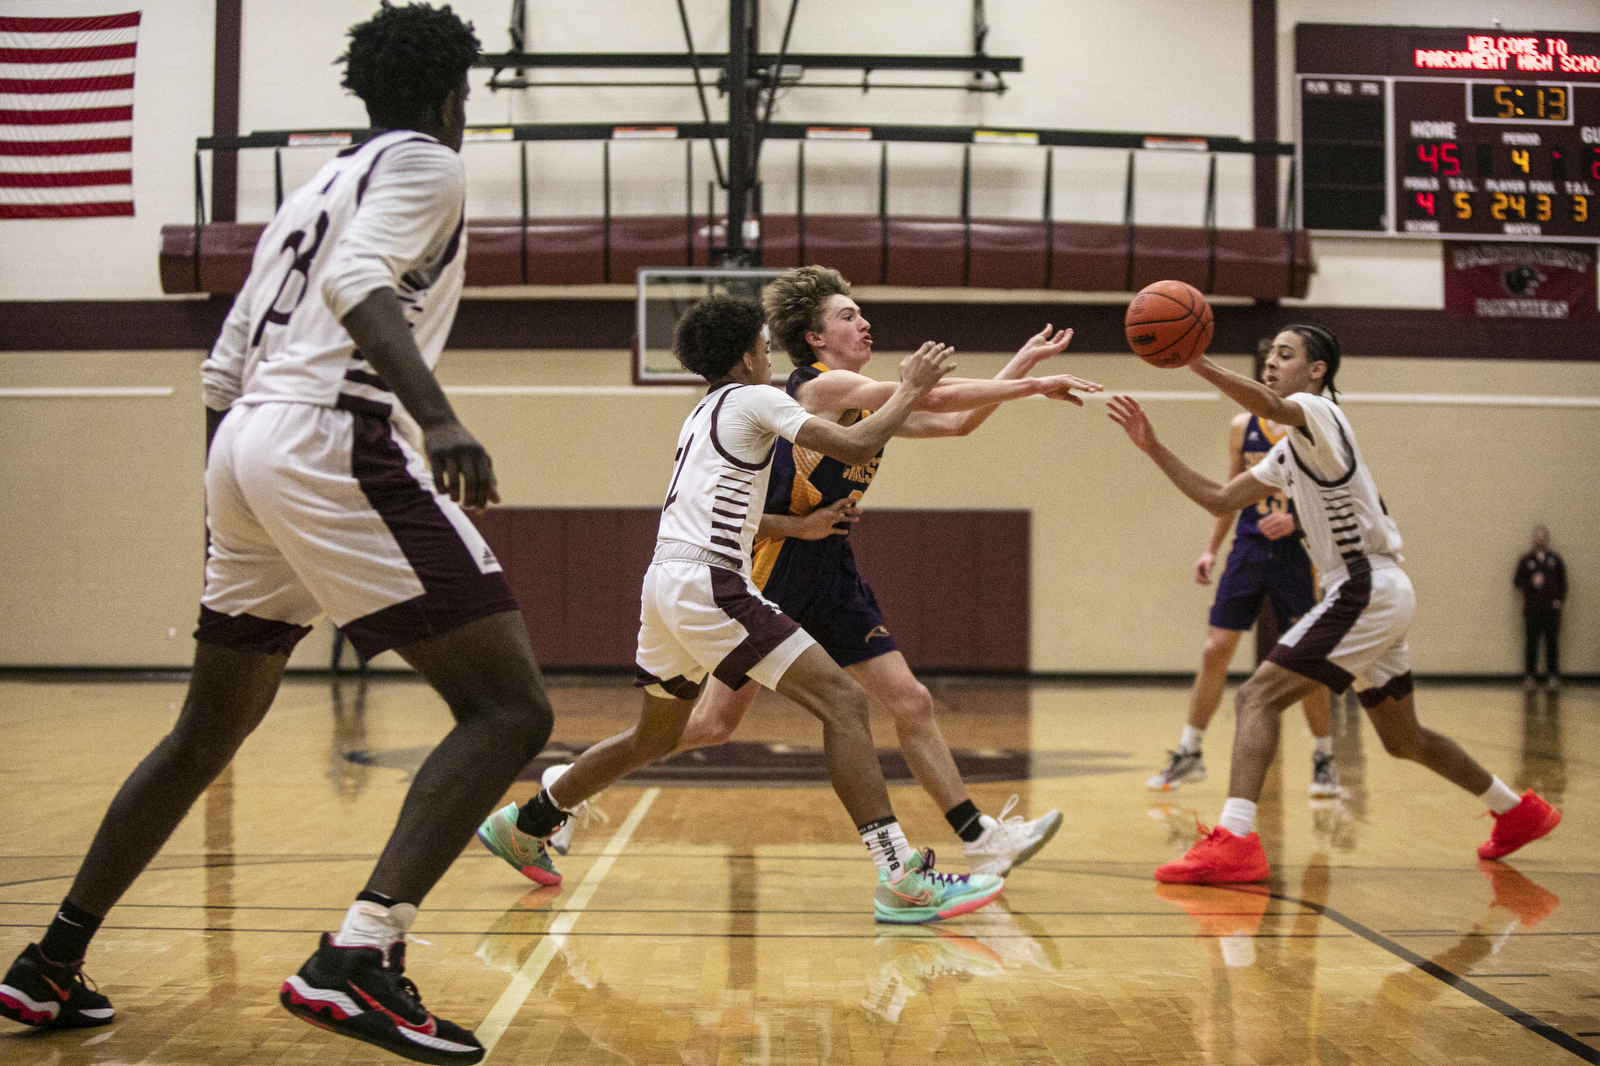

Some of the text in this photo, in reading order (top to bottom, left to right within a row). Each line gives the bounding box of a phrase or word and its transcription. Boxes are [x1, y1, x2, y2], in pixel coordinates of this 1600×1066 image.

[1466, 35, 1568, 56] WELCOME TO
[1414, 49, 1600, 73] PARCHMENT HIGH SCHO
[1493, 86, 1566, 120] 5:13
[1410, 121, 1457, 139] HOME
[1417, 143, 1460, 176] 45
[1511, 149, 1530, 173] 4
[1416, 192, 1435, 216] 4
[1453, 191, 1472, 219] 5
[1491, 192, 1526, 220] 24
[1536, 193, 1551, 221] 3
[1573, 194, 1588, 222] 3
